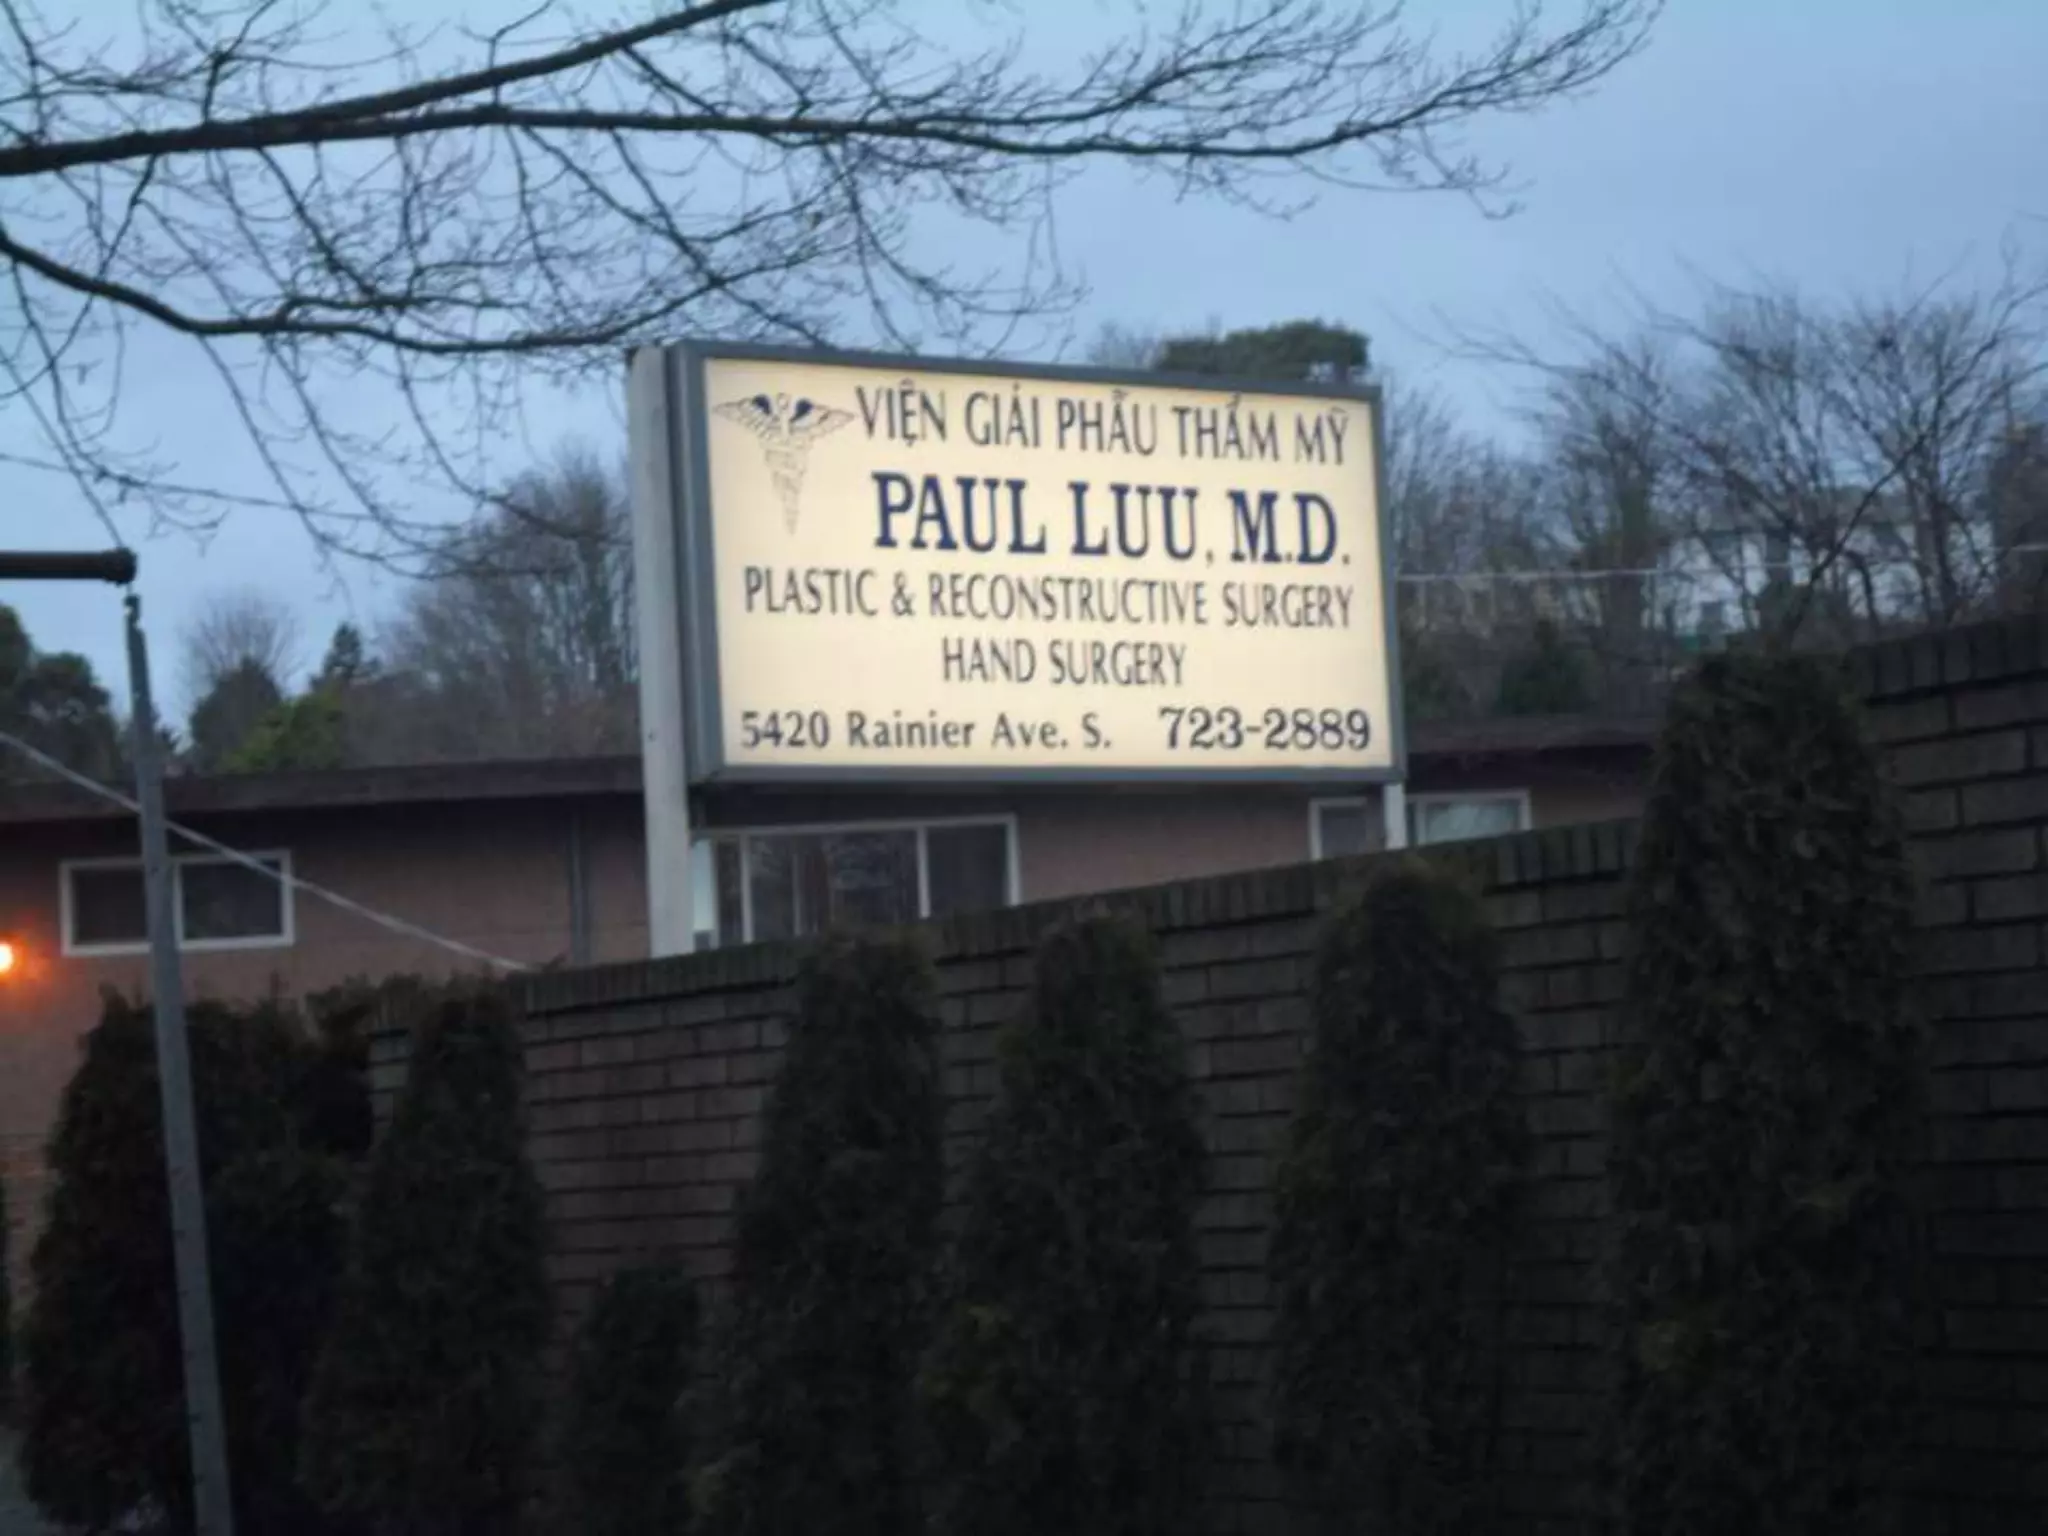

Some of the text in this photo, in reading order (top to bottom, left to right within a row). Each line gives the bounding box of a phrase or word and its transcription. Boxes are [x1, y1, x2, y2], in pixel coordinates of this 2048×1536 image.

[870, 470, 1048, 556] PAUL
[1225, 488, 1351, 567] M.D.
[744, 565, 1355, 629] PLASTIC & RECONSTRUCTIVE SURGERY
[942, 636, 1186, 688] HAND SURGERY
[740, 706, 1371, 752] 5420 Rainier Ave. S. 723-2889
